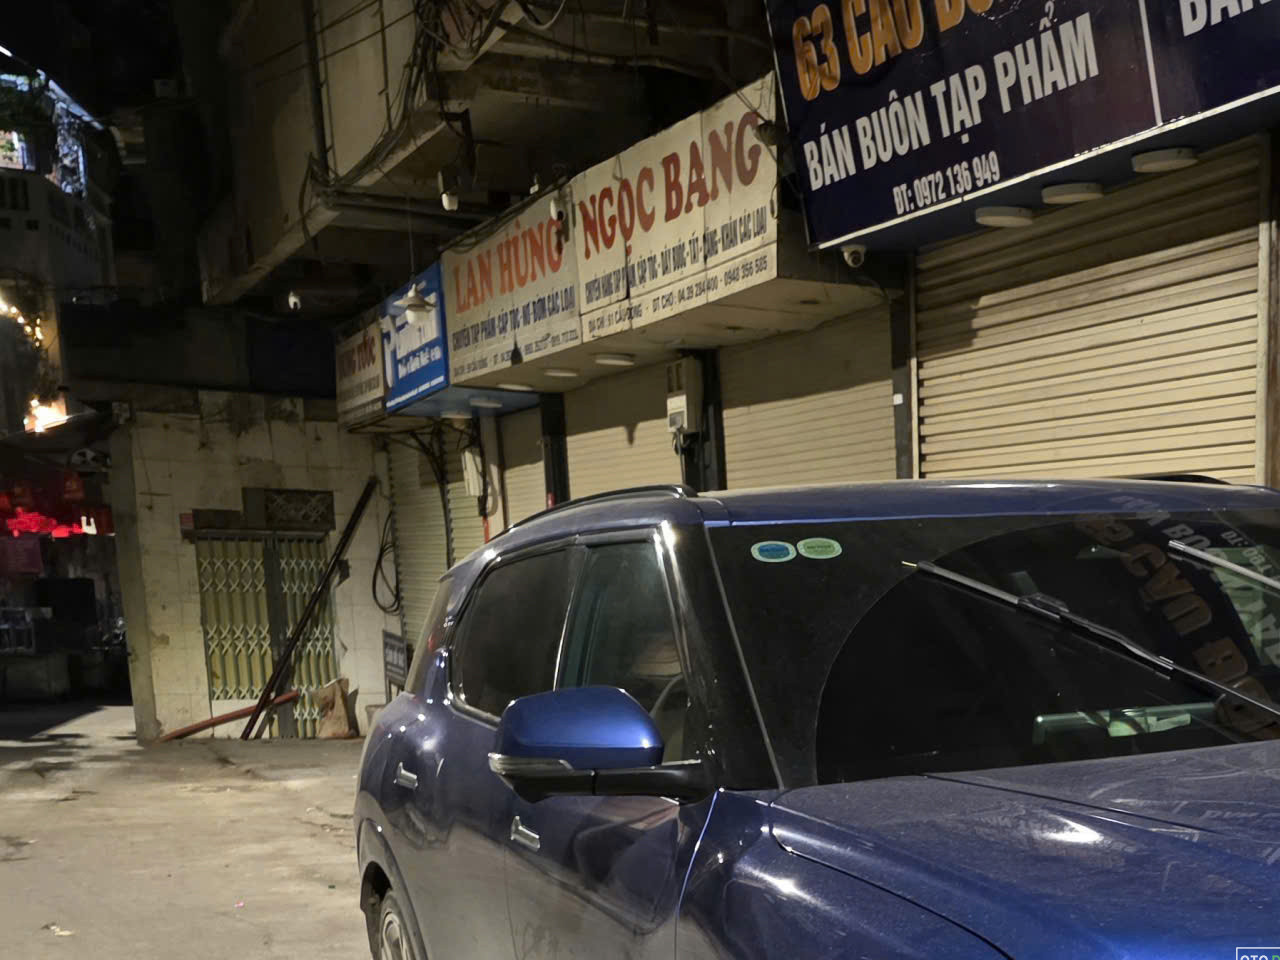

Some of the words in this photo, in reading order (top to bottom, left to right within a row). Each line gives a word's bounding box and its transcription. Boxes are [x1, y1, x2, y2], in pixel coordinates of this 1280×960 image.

[792, 4, 841, 101] 63
[803, 122, 857, 191] BÁN
[855, 89, 931, 171] BUÔN
[930, 65, 987, 144] TẠP
[993, 1, 1099, 114] PHẨM
[578, 167, 656, 260] NGỌC
[913, 170, 946, 207] 0972
[946, 161, 972, 195] 136
[972, 151, 1000, 187] 949
[453, 248, 494, 314] LAN
